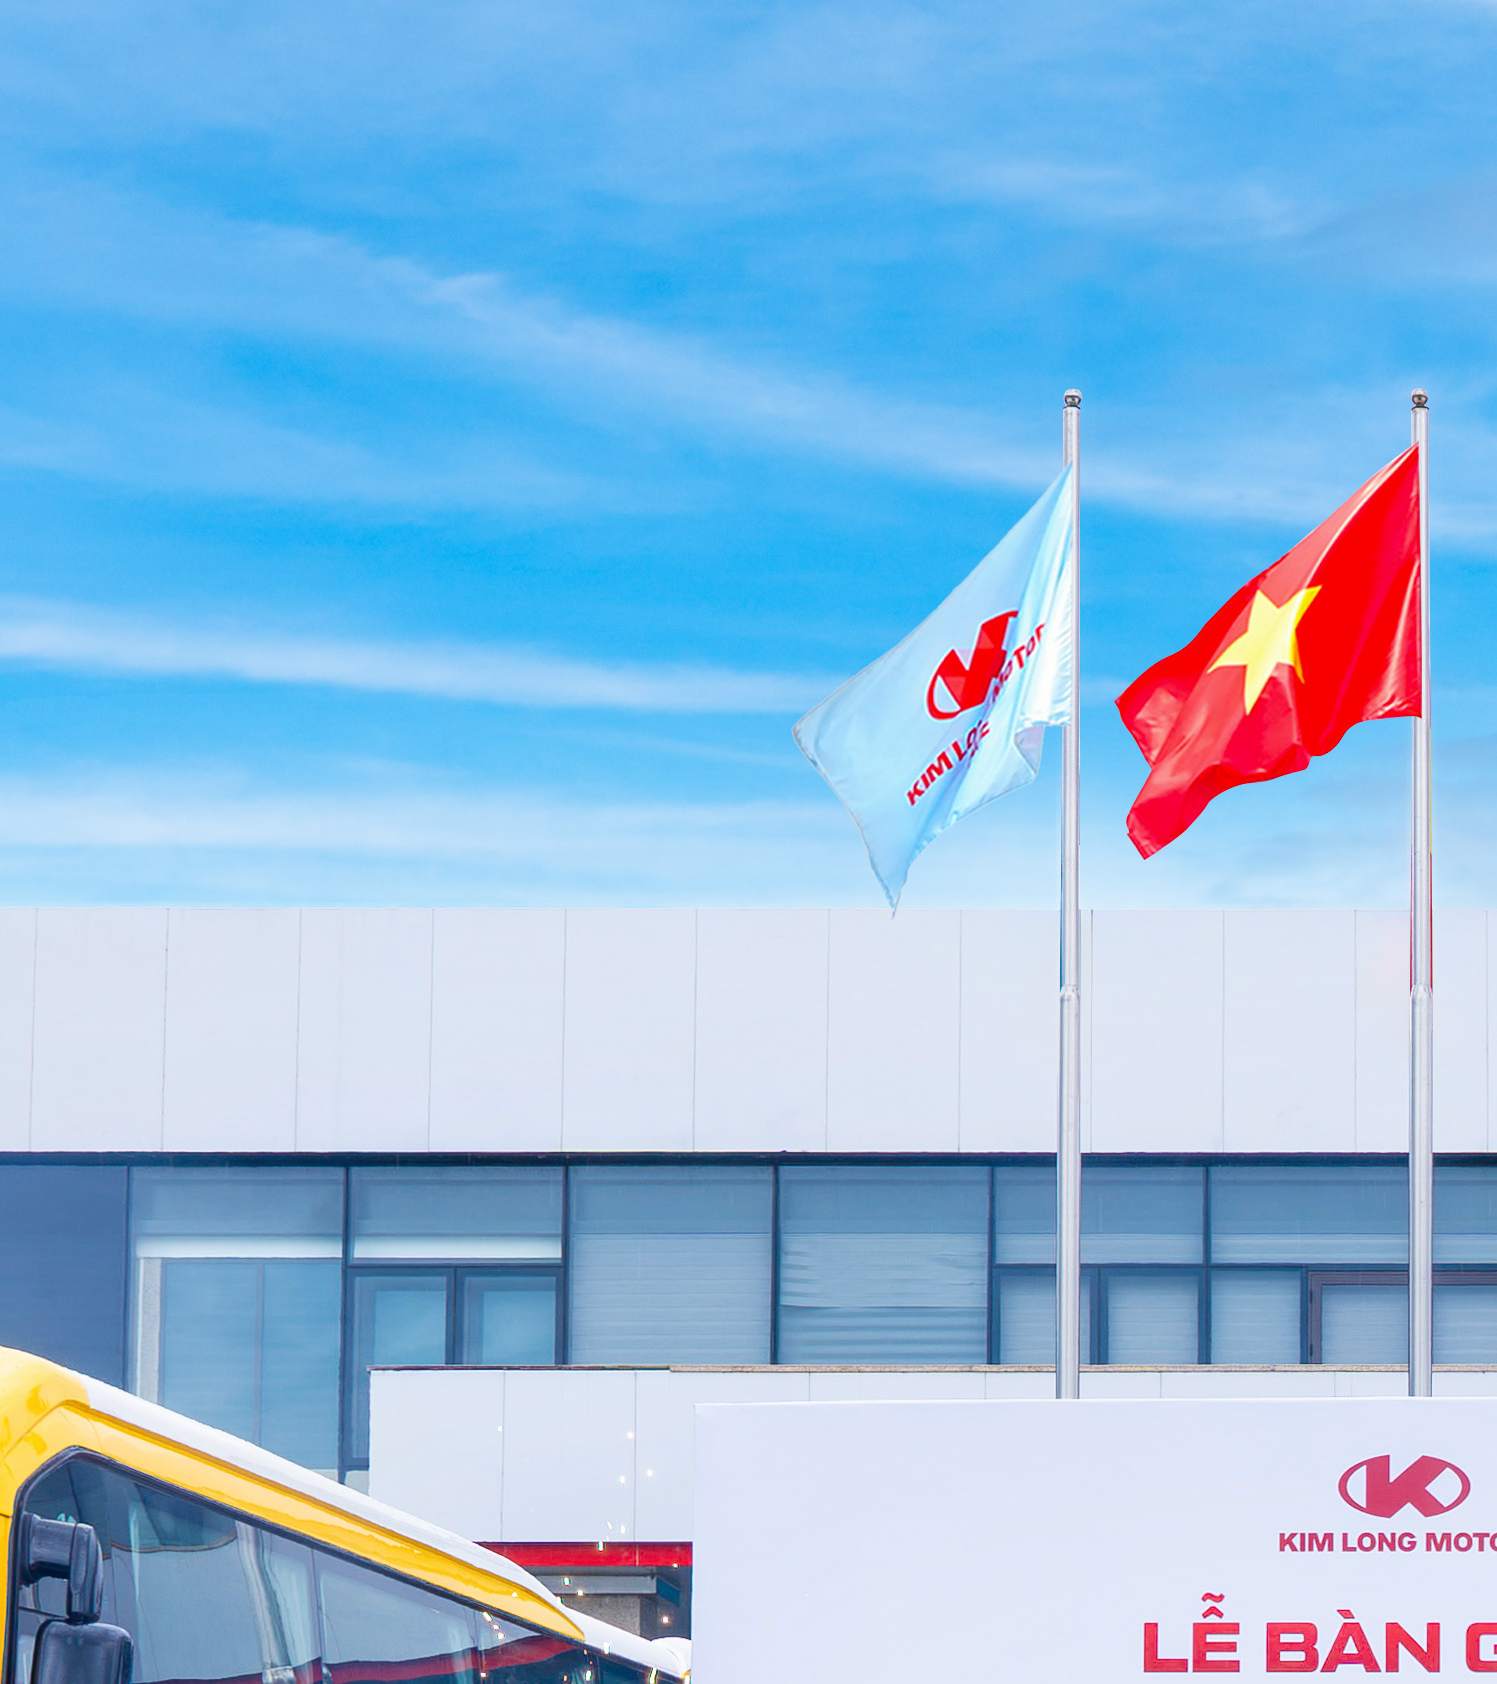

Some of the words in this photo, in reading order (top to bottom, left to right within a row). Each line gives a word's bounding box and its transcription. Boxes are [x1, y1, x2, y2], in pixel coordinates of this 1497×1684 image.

[907, 751, 954, 806] KIM
[1279, 1532, 1334, 1552] KIM
[1342, 1532, 1417, 1553] LONG
[1143, 1592, 1241, 1673] LỄ
[1266, 1609, 1441, 1673] BÀN
